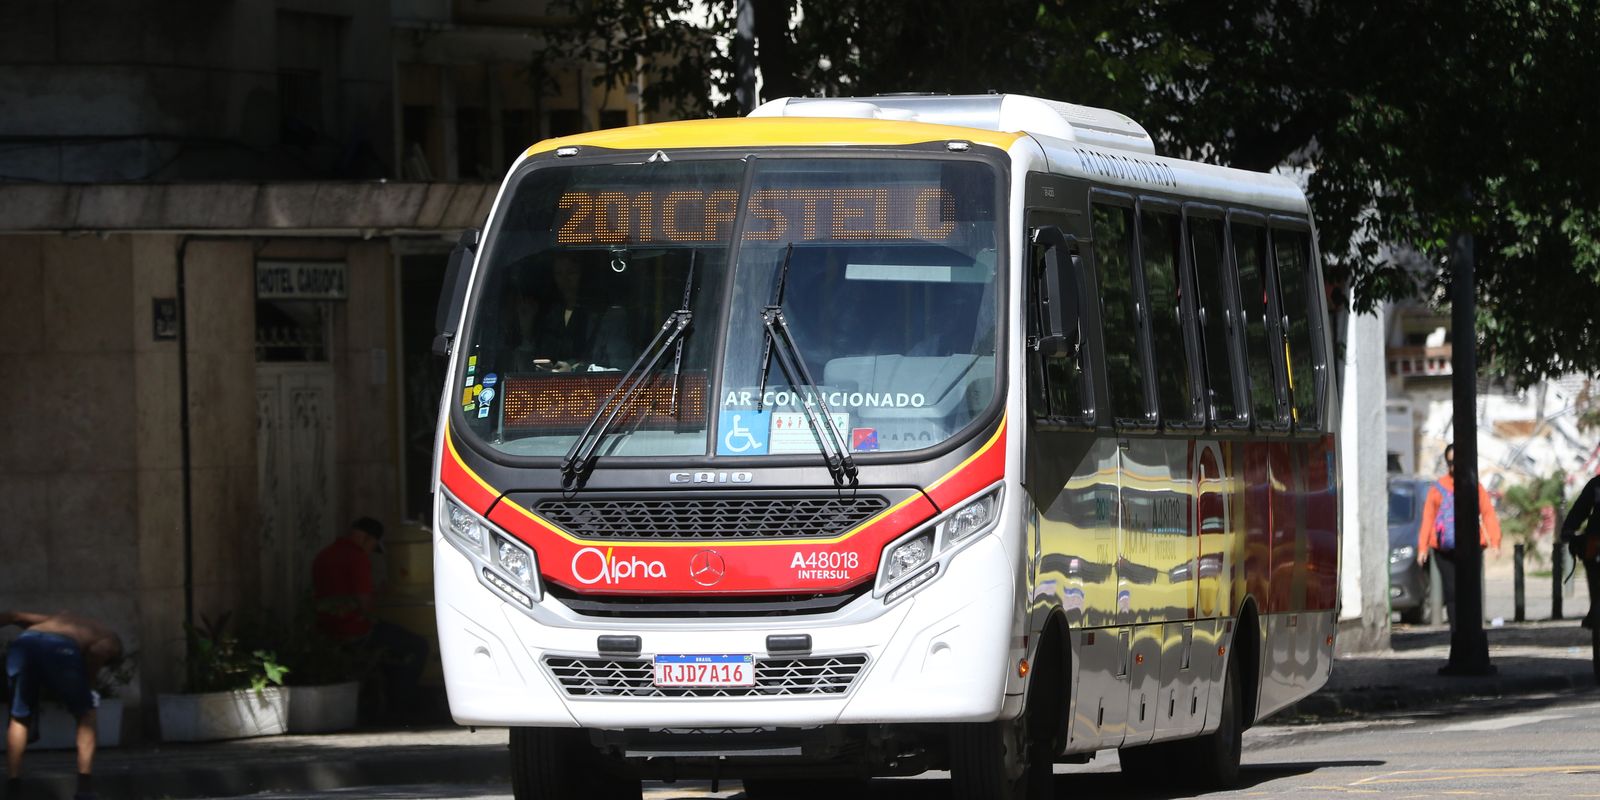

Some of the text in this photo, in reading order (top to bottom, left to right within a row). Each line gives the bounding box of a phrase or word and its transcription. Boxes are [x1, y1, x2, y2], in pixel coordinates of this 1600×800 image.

[557, 188, 957, 243] 201 CASTELO
[258, 268, 294, 293] HOTEL
[725, 391, 752, 406] AR
[669, 472, 753, 483] CAIO
[790, 551, 859, 569] A48018
[798, 570, 850, 579] INTERSUL
[663, 664, 743, 683] RJD7A16
